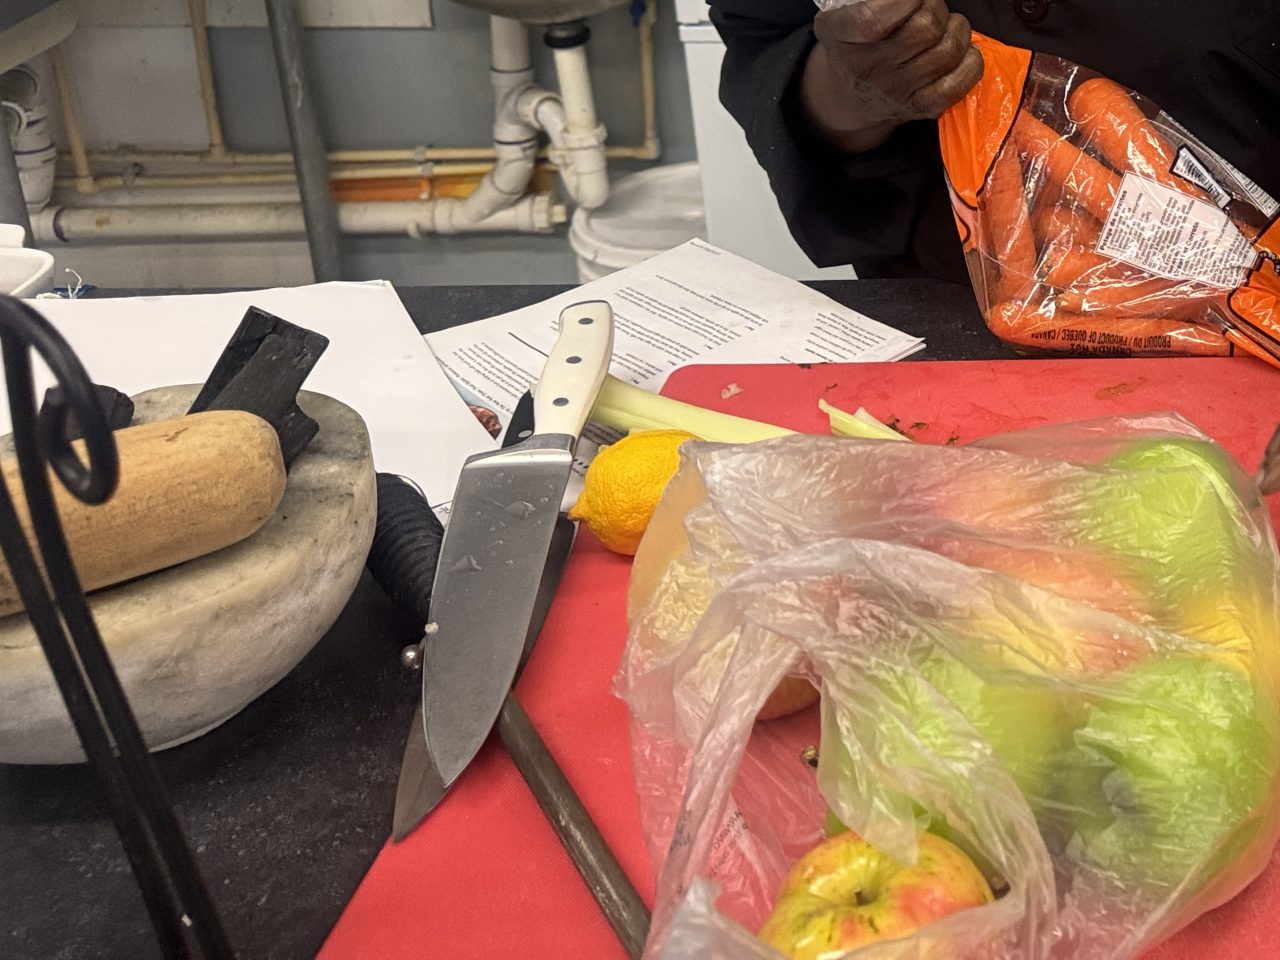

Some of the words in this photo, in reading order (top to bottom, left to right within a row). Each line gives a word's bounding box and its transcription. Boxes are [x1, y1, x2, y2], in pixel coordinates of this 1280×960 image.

[1061, 328, 1087, 342] QUEBEC
[1088, 332, 1096, 343] OF
[1098, 331, 1128, 346] PRODUCT
[1144, 335, 1170, 348] PRODUIT
[1134, 337, 1142, 348] DU
